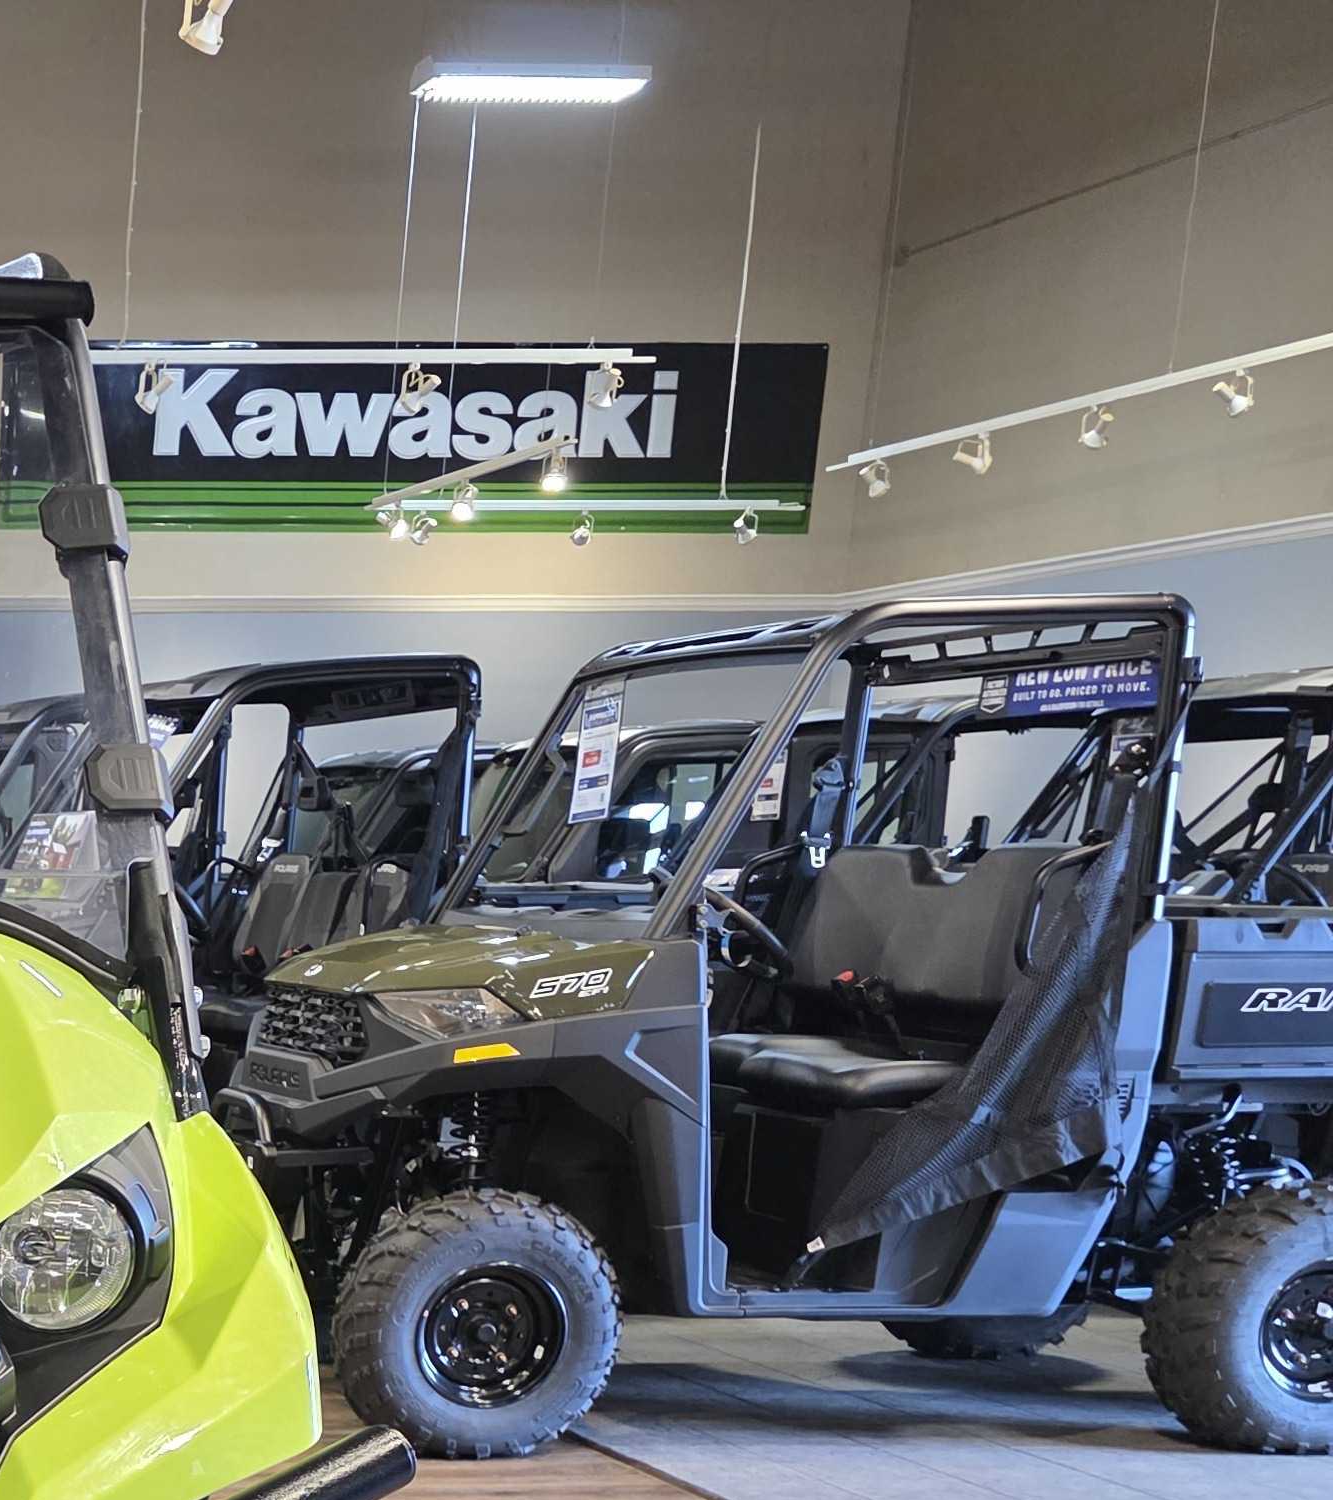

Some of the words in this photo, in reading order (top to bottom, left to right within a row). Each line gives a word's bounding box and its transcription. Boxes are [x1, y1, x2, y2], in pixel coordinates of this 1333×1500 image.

[152, 368, 679, 459] Kawasaki
[1015, 670, 1049, 687] NEW
[1052, 665, 1088, 684] LOW
[1092, 659, 1154, 680] PRICE
[1064, 684, 1098, 697] PRICED
[1101, 683, 1114, 693] TO
[1116, 681, 1151, 693] MOVE.
[528, 967, 613, 999] 570
